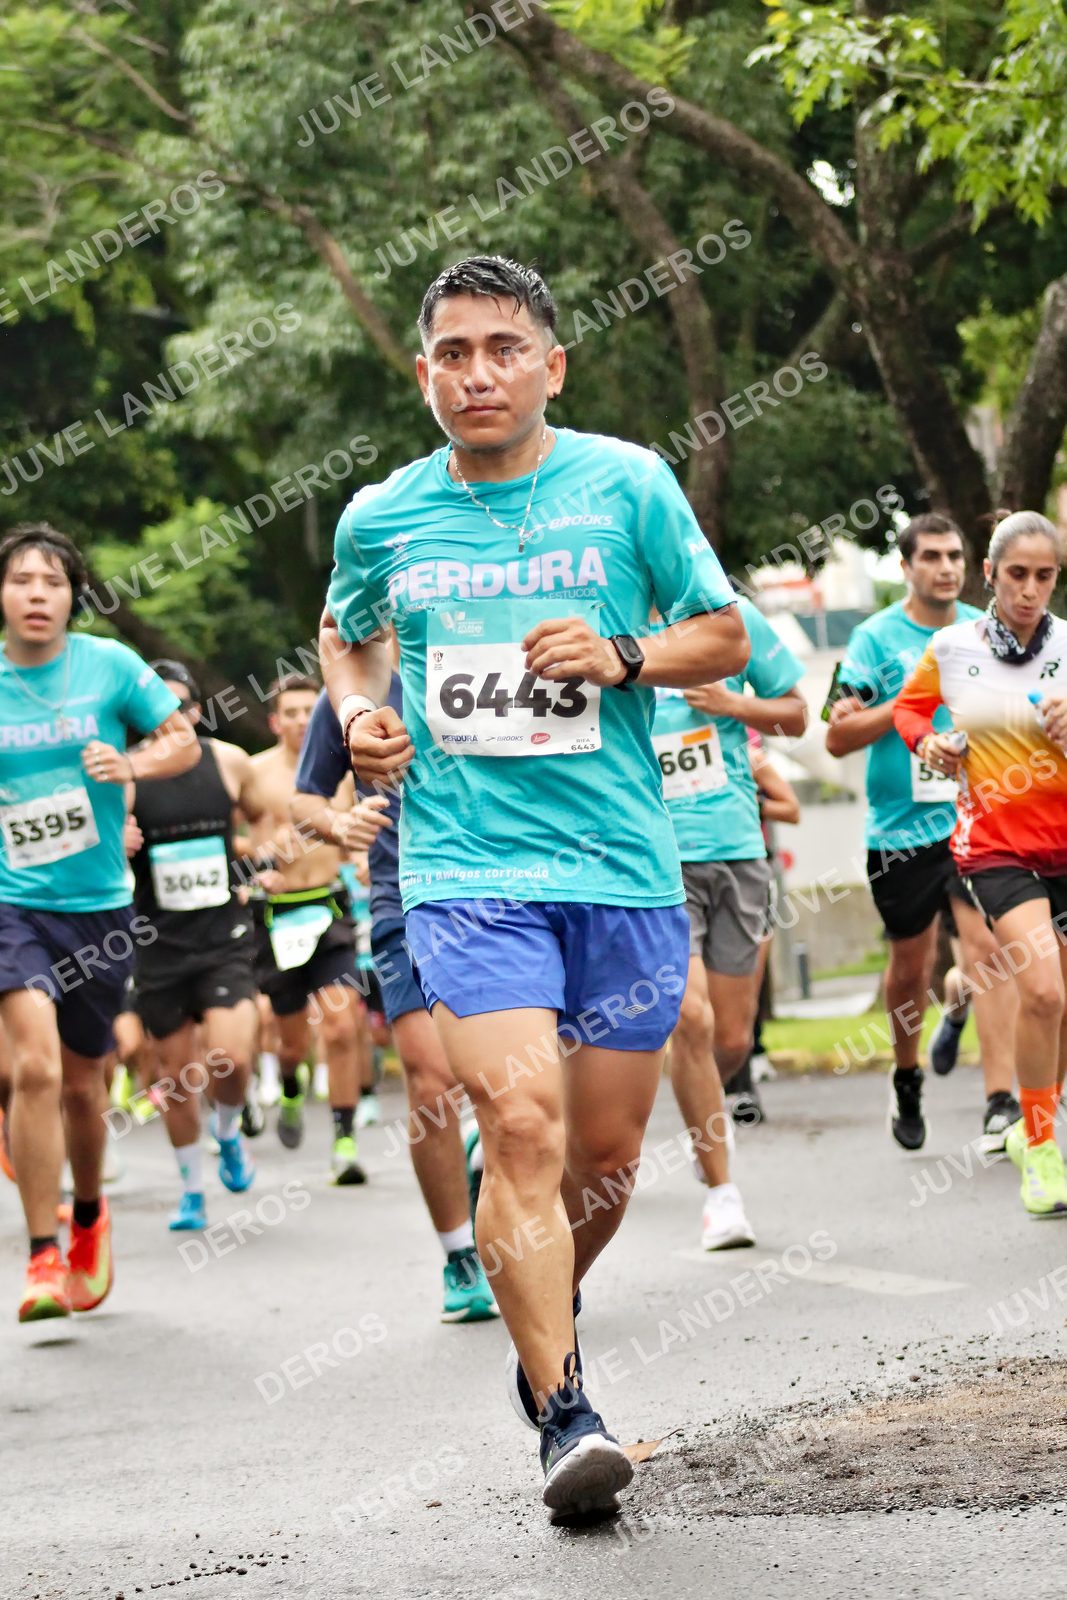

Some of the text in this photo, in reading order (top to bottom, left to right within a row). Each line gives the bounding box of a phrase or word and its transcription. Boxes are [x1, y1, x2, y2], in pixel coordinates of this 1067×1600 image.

[550, 515, 613, 529] BROOKS
[386, 547, 608, 609] PERDURA
[550, 587, 597, 601] ESTUCOS
[440, 672, 588, 720] 6443
[658, 743, 713, 776] 661
[10, 806, 87, 846] 5395
[485, 867, 549, 879] corriendo
